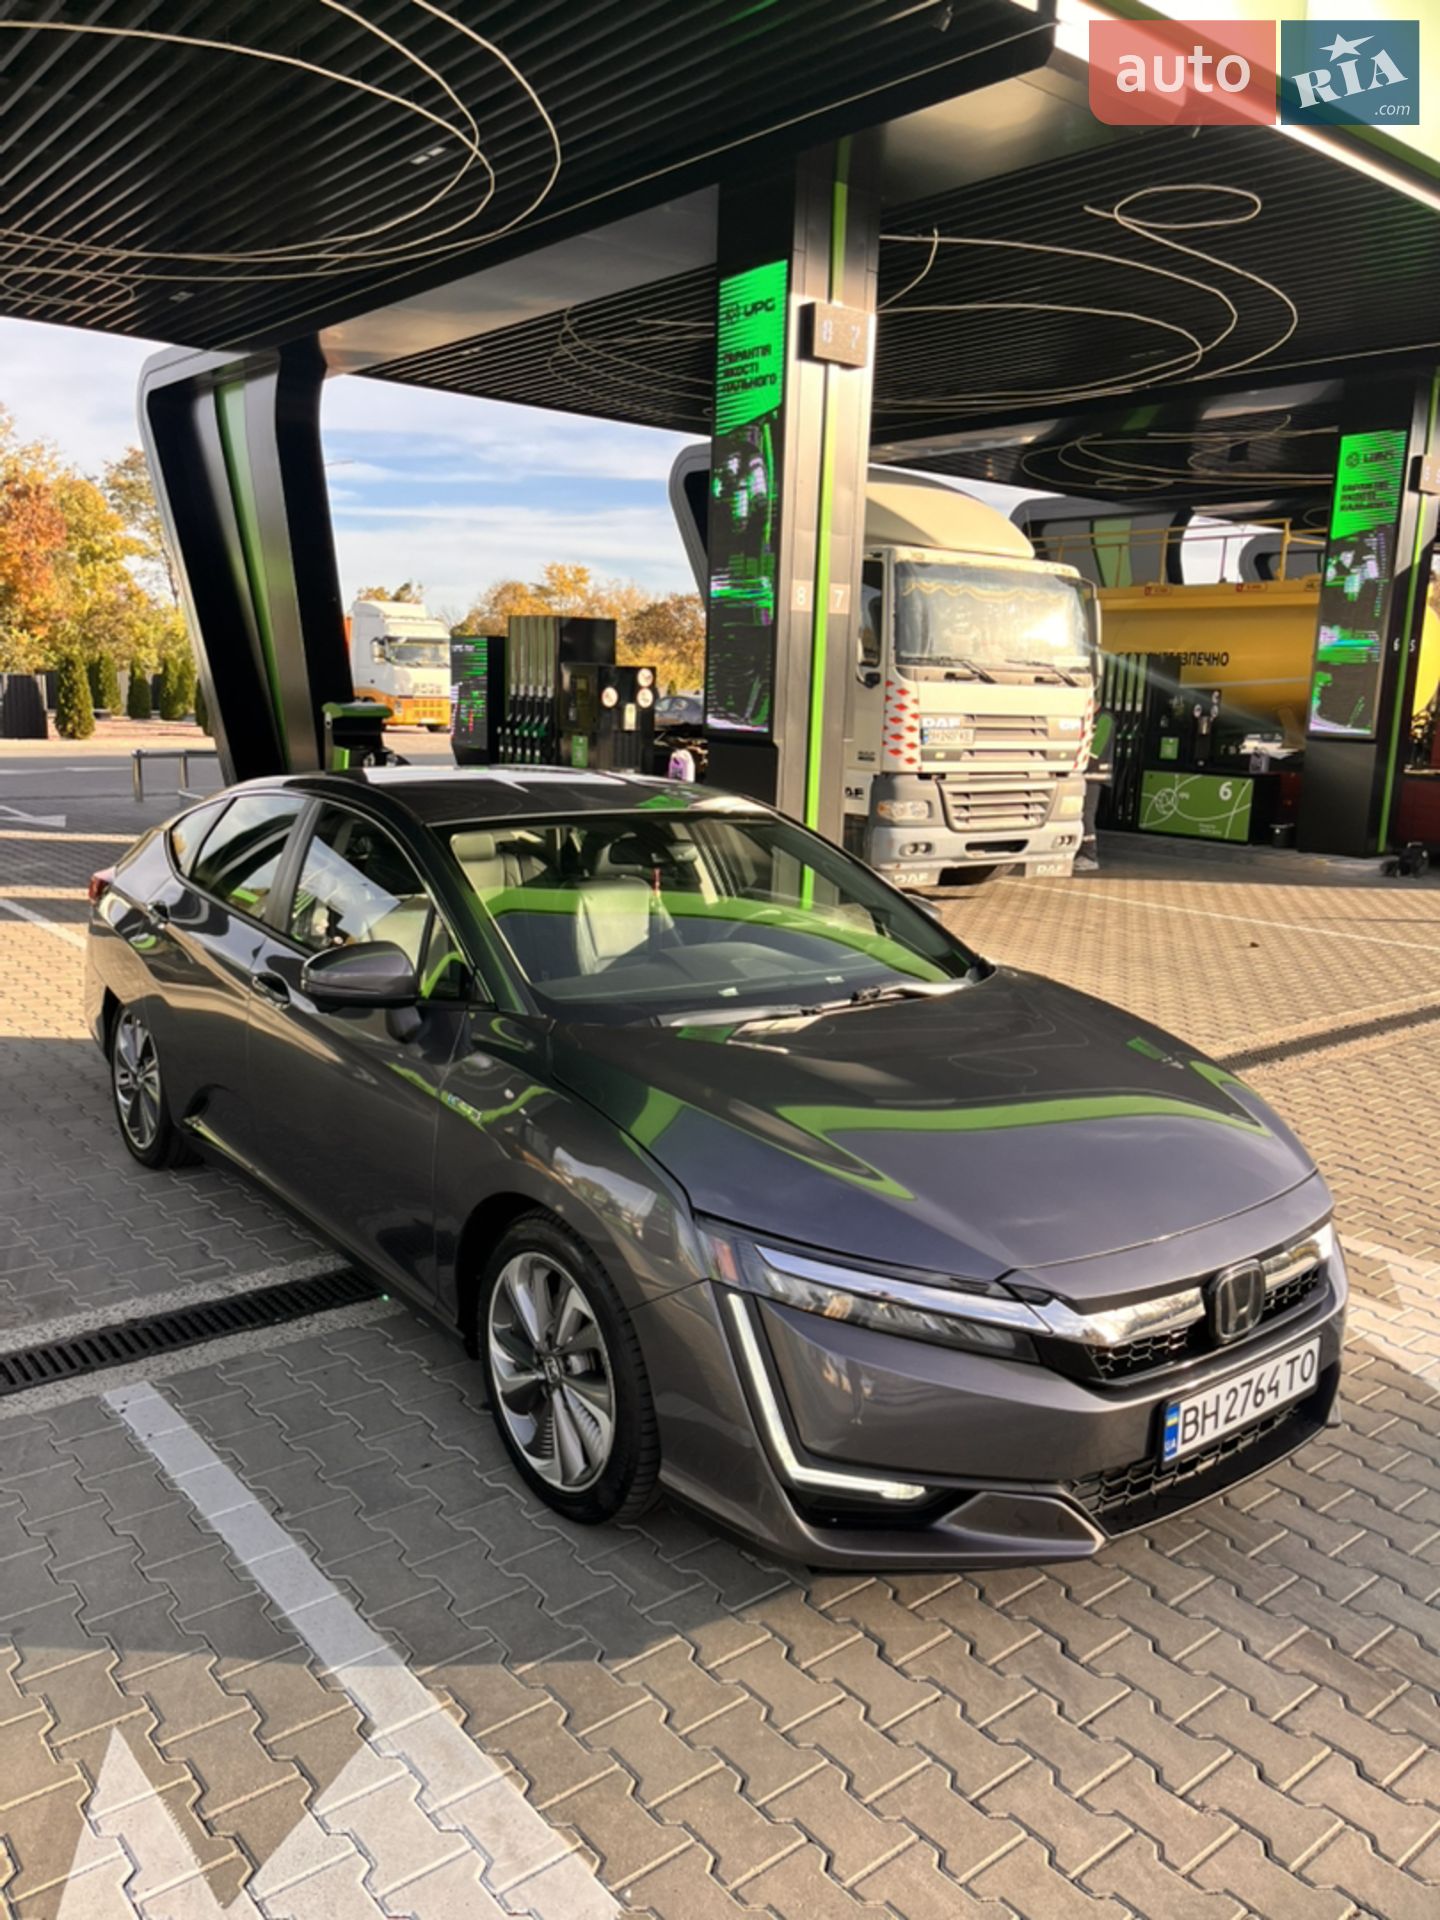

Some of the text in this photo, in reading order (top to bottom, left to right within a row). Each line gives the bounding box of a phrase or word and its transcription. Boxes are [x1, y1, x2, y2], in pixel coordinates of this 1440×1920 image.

[795, 586, 806, 607] 8
[833, 589, 844, 609] 7
[921, 716, 961, 729] DAF
[1218, 781, 1233, 801] 6
[1035, 864, 1065, 876] DAF
